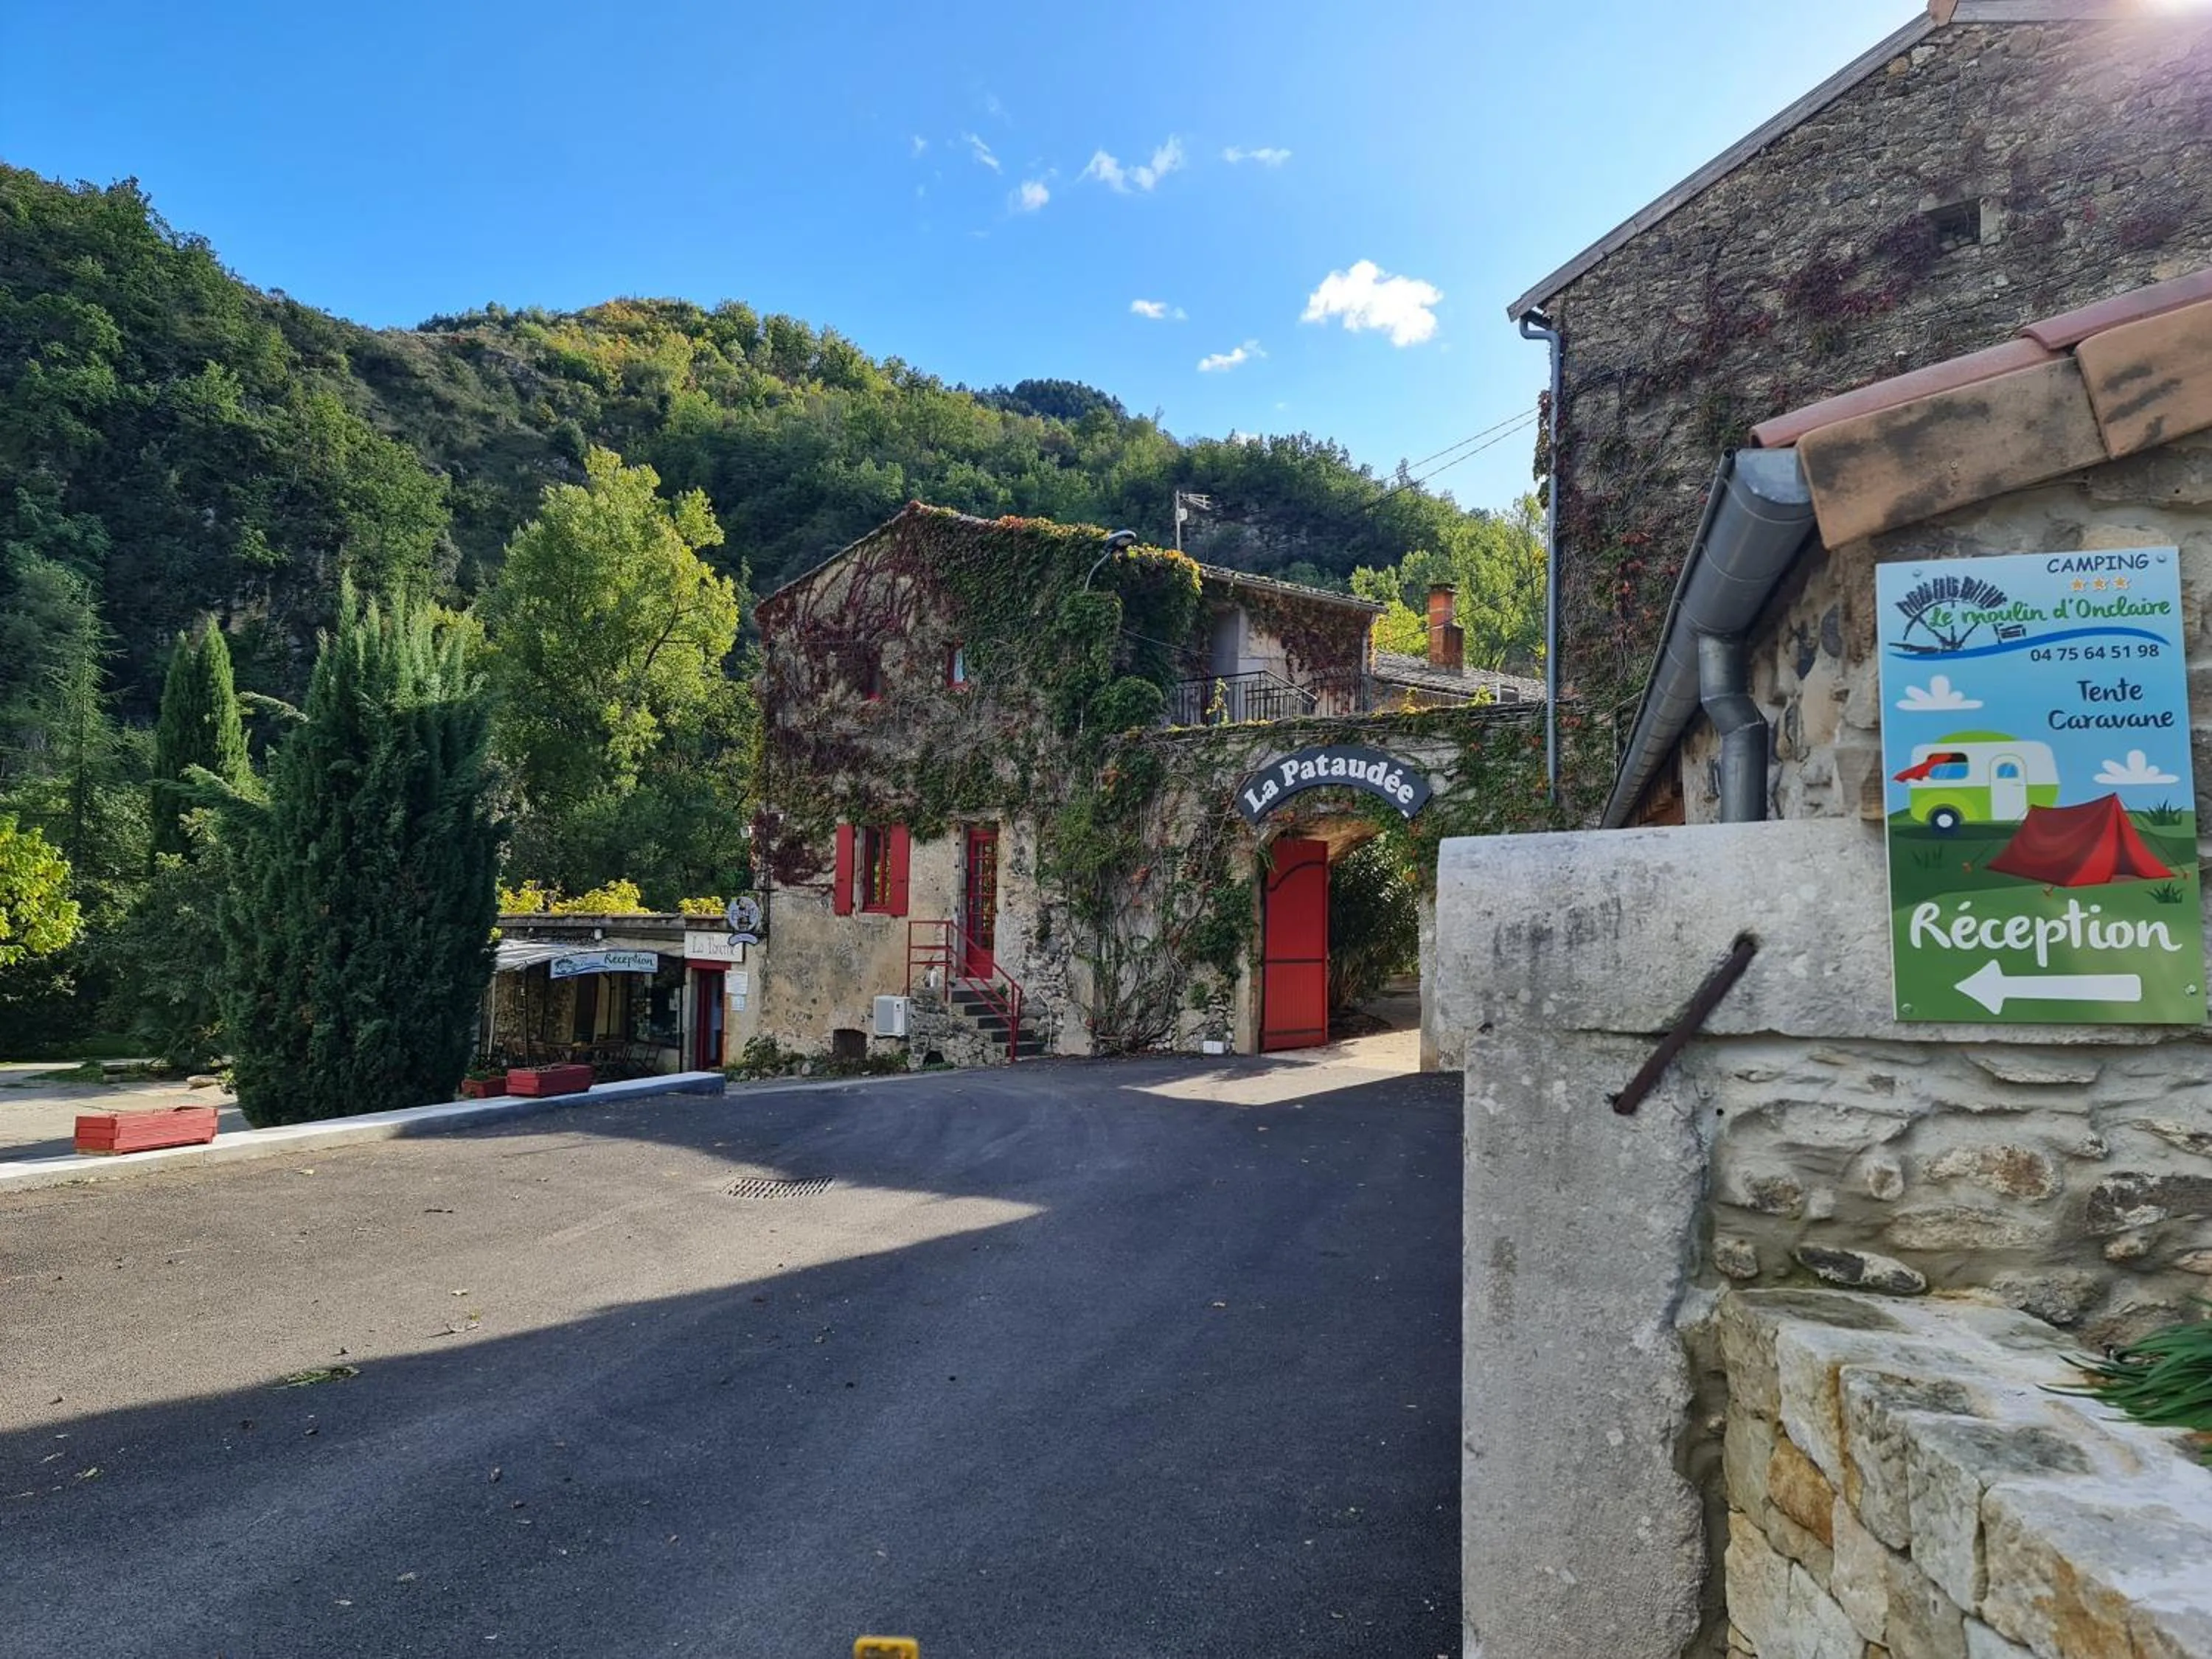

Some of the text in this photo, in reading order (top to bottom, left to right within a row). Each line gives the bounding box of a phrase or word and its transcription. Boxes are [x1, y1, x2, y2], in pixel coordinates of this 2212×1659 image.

[2047, 554, 2149, 573] CAMPING
[1930, 607, 1953, 627] Le
[1961, 601, 2048, 625] moulin
[2030, 644, 2160, 662] 04 75 64 51 98
[2076, 678, 2144, 702] Tente
[2048, 709, 2174, 731] Caravane
[1244, 754, 1414, 813] La Pataudée
[1910, 899, 2183, 968] Réception
